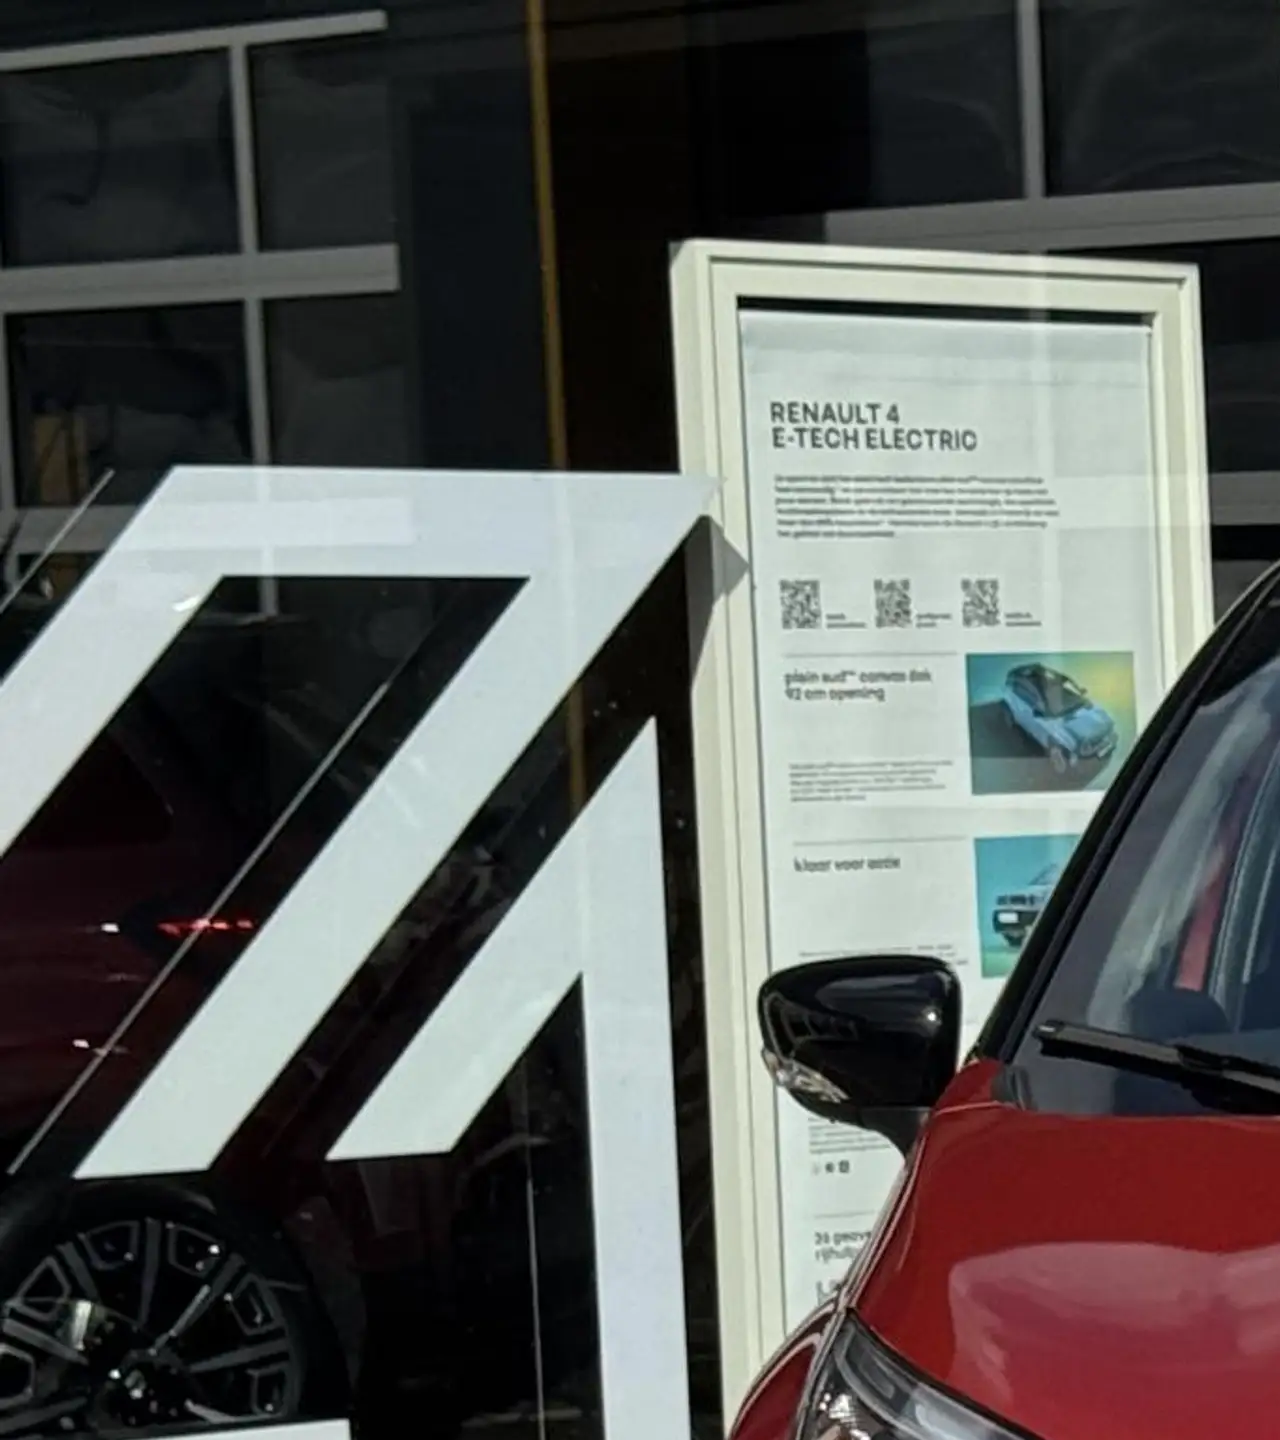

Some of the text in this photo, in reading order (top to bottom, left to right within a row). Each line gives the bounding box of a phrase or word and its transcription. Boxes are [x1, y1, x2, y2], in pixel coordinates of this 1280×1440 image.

[770, 402, 899, 424] RENAULT 4
[772, 427, 977, 451] E-TECH ELECTRIC
